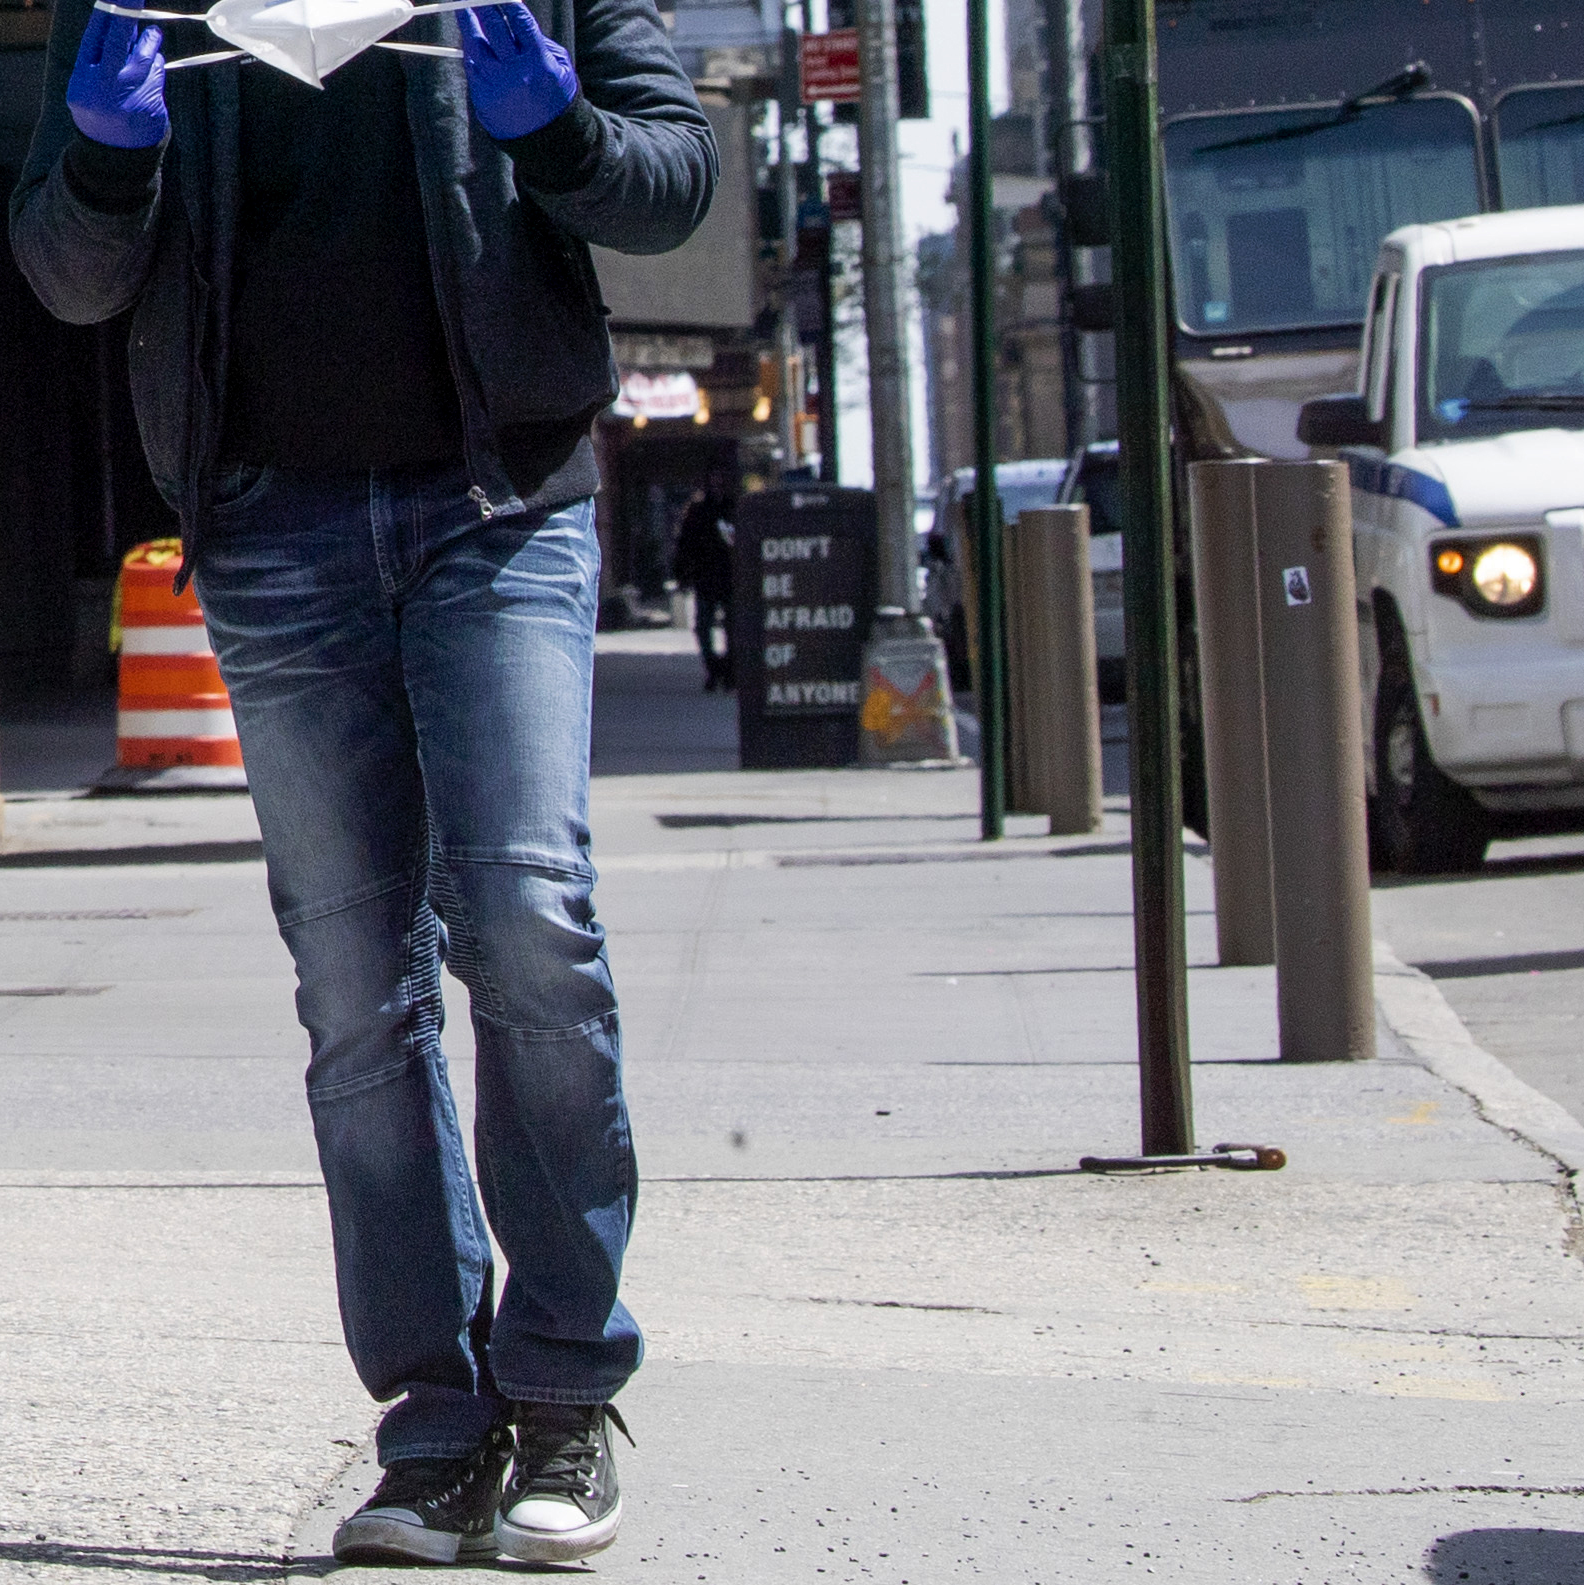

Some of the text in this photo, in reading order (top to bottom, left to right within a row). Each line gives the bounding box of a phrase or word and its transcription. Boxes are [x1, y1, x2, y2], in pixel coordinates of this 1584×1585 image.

[762, 536, 830, 561] DON'T
[763, 574, 793, 598] BE
[764, 605, 854, 630] AFRAID
[764, 643, 796, 668] OF
